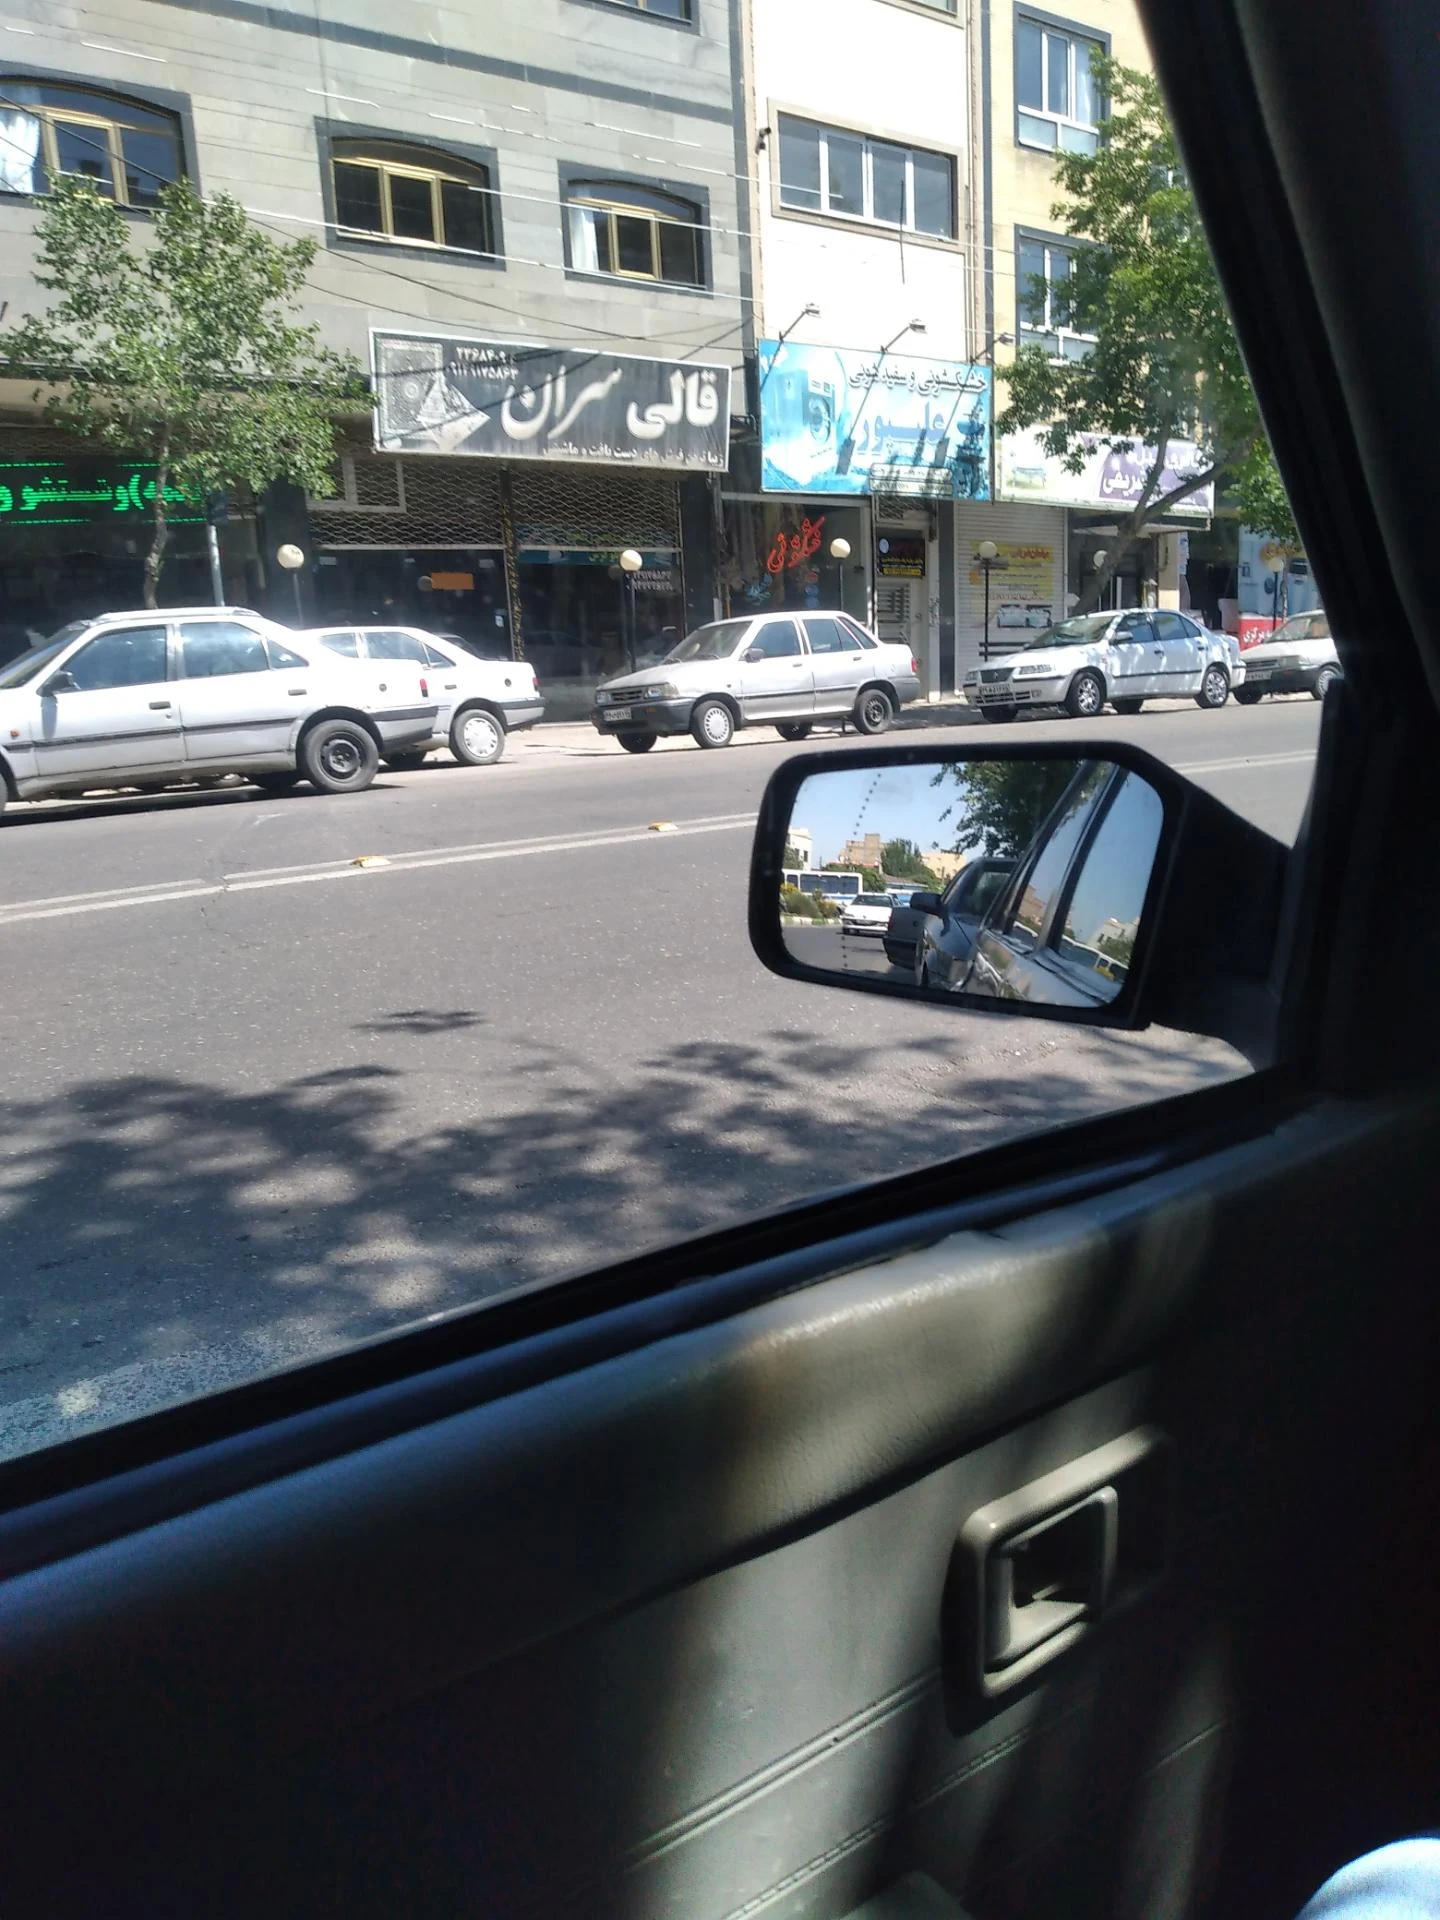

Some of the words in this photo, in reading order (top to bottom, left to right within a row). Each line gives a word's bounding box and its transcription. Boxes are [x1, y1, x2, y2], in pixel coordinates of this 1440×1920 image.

[908, 371, 916, 393] و
[626, 367, 719, 440] قالی
[614, 447, 638, 458] دست
